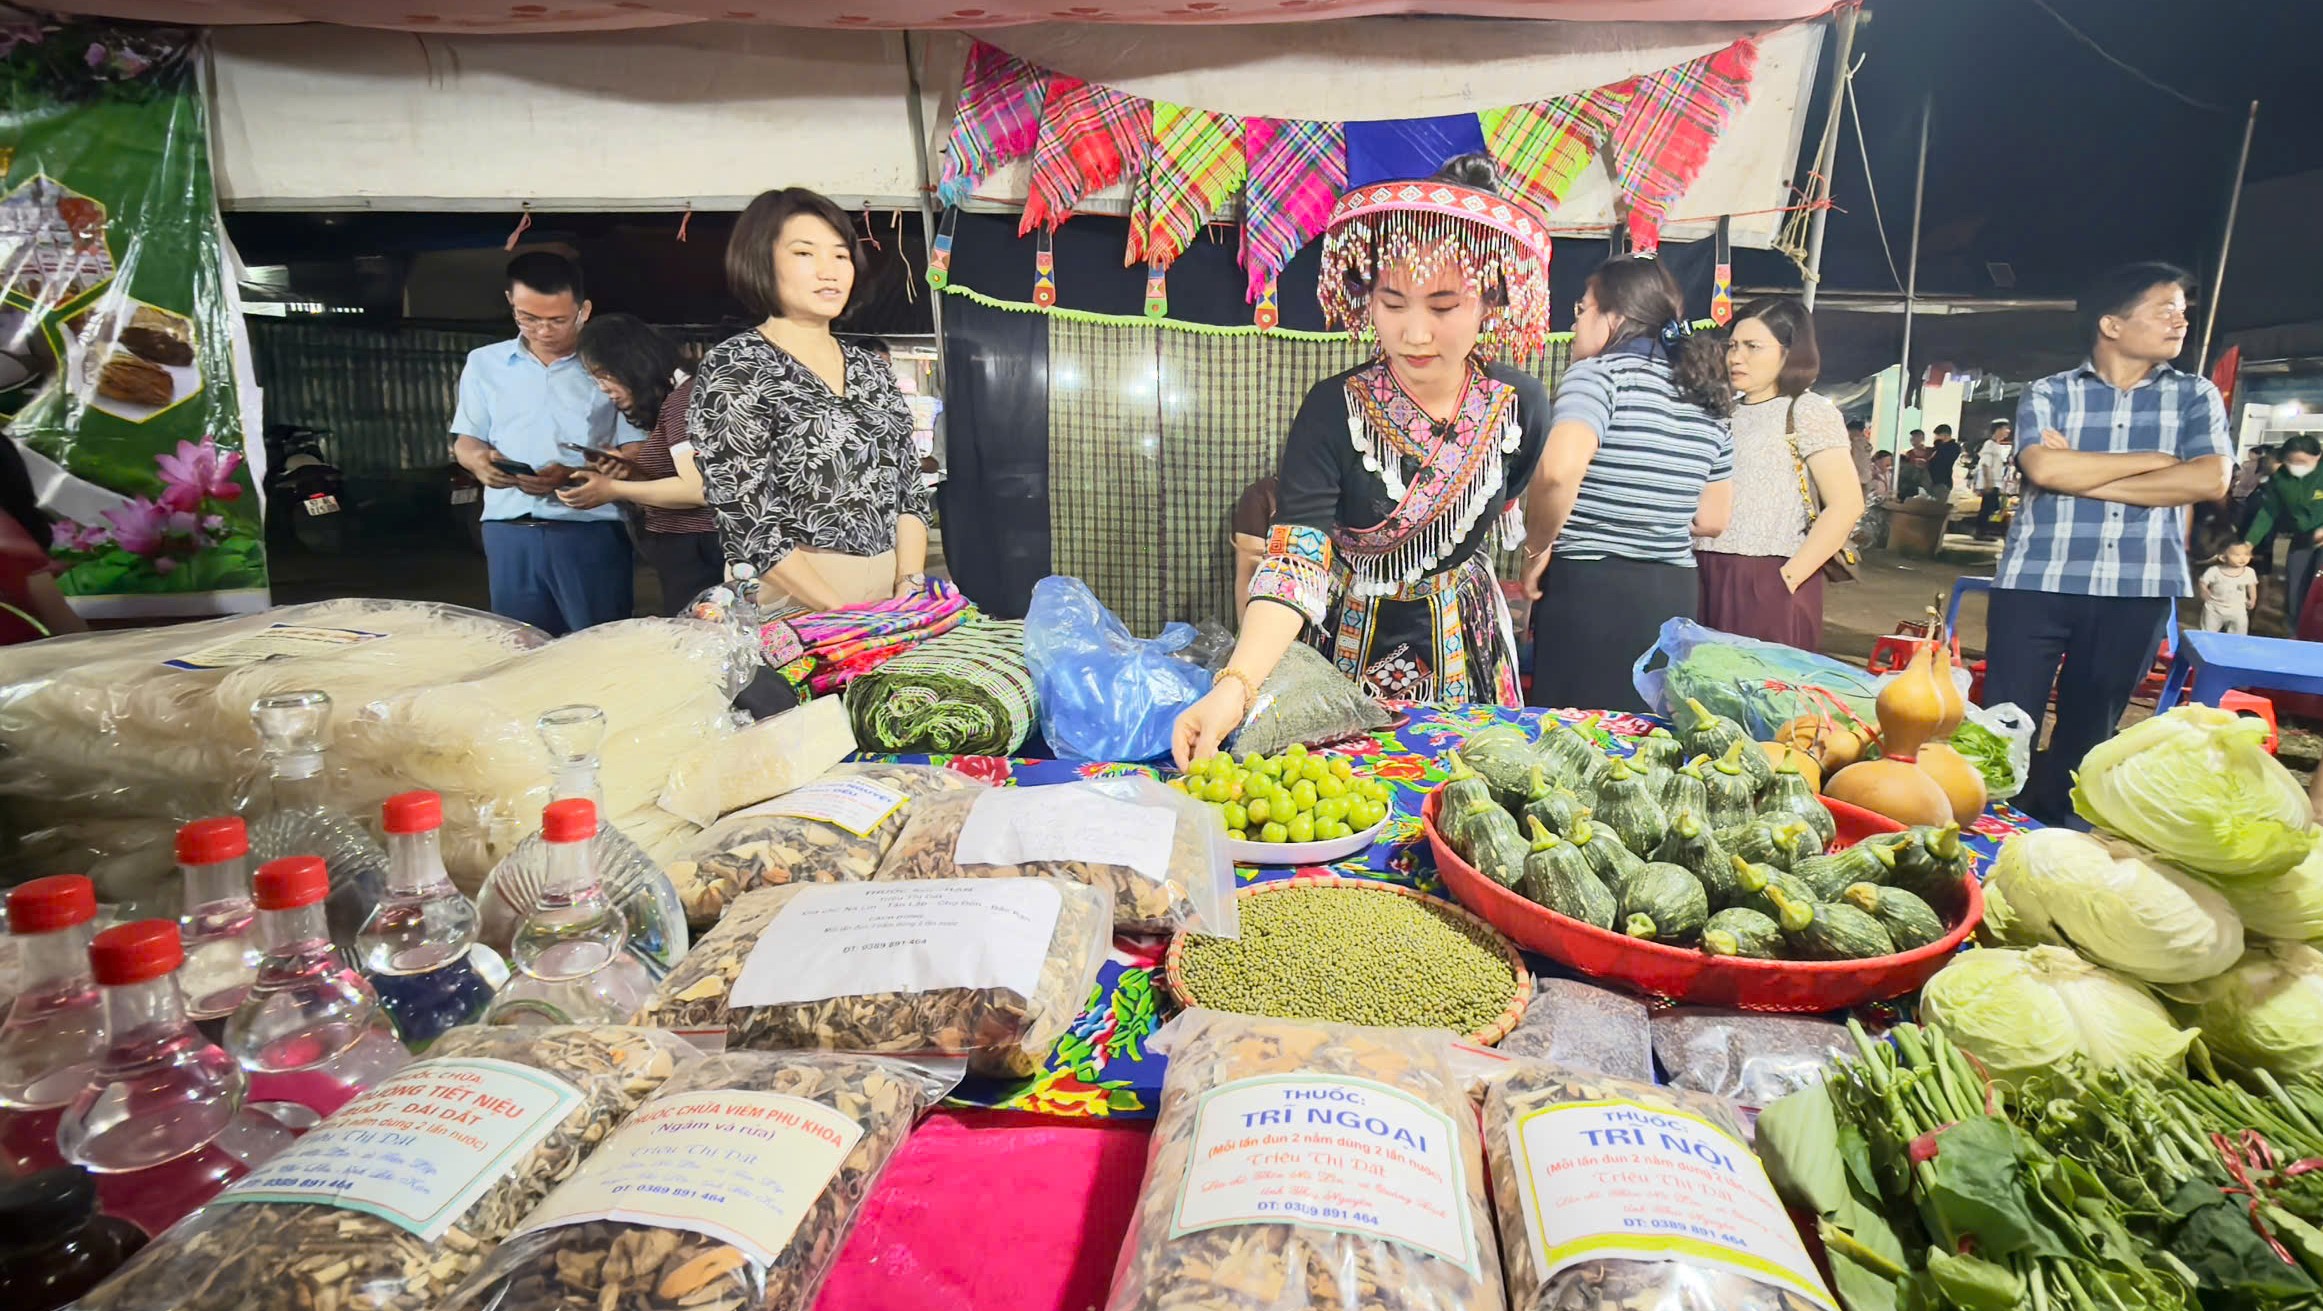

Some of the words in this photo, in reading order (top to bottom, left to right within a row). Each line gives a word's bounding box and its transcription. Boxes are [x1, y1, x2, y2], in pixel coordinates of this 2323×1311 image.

[428, 1083, 475, 1102] TIẾT
[471, 1092, 525, 1120] NIỆU
[1282, 1085, 1367, 1106] THUỐC:
[676, 1099, 722, 1117] CHỮA
[765, 1108, 801, 1129] PHỤ
[800, 1119, 844, 1149] KHOA
[1240, 1103, 1297, 1129] TRĨ
[1307, 1107, 1429, 1154] NGOẠI
[1262, 1133, 1289, 1145] đun
[1291, 1132, 1302, 1144] 2
[1374, 1145, 1383, 1156] 2
[1578, 1122, 1646, 1148] TRĨ
[1658, 1132, 1737, 1174] NỘI
[1631, 1153, 1642, 1164] 2
[636, 1183, 671, 1195] 0389
[672, 1188, 698, 1200] 891
[700, 1191, 727, 1204] 464
[1322, 1206, 1348, 1220] 891
[1352, 1211, 1380, 1226] 464
[1650, 1217, 1688, 1231] 0389
[1690, 1225, 1717, 1240] 891
[1721, 1233, 1748, 1248] 464
